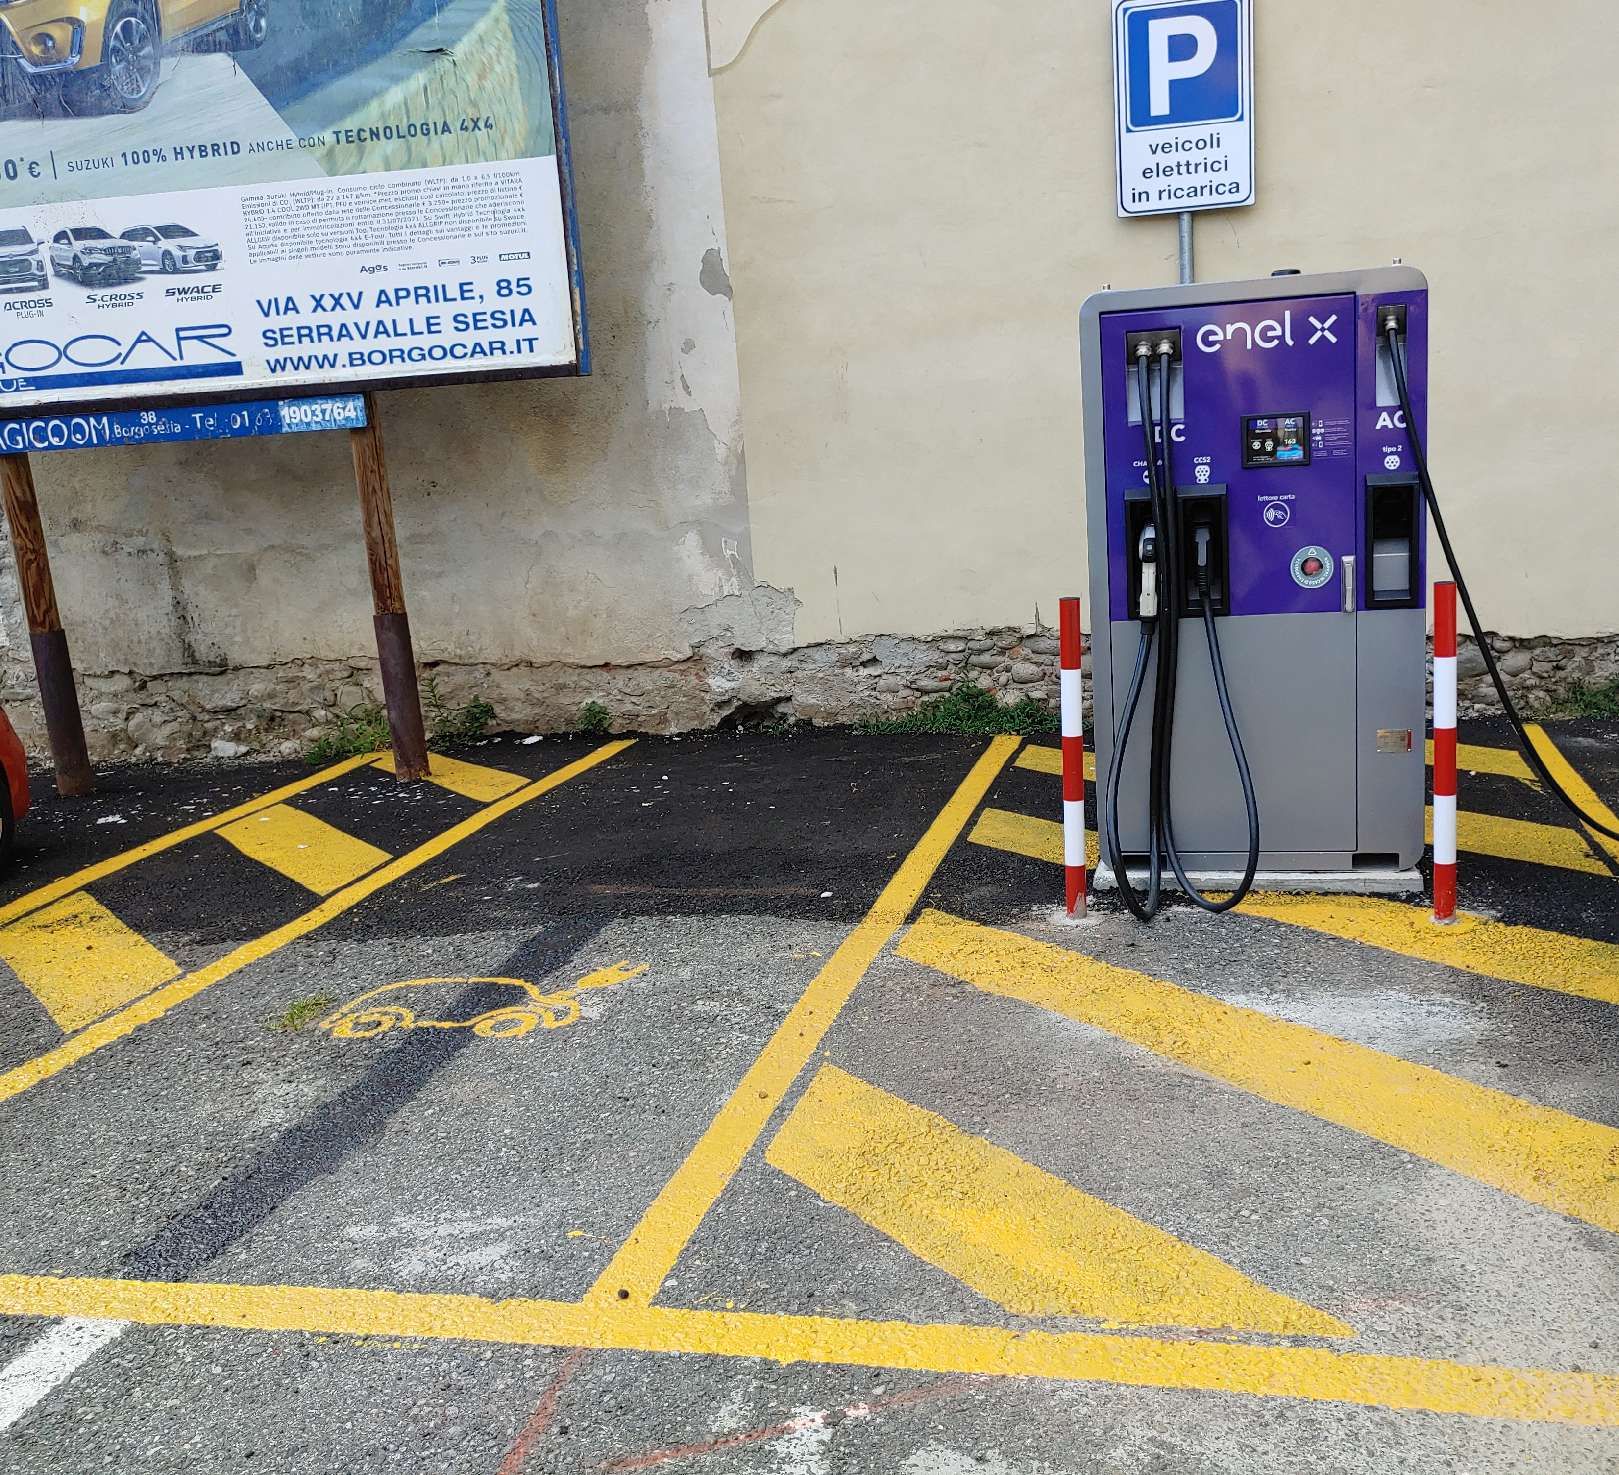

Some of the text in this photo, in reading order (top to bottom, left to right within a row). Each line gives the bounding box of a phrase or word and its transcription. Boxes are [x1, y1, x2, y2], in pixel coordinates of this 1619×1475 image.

[1148, 15, 1218, 117] P
[67, 116, 494, 172] SUZUKI 100% HYBRID ANCHE CON TECNOLOGIA 4X4
[1149, 132, 1220, 155] veicoli
[1142, 155, 1228, 179] elettrici
[1131, 180, 1240, 203] in ricarica
[360, 264, 388, 274] Agos
[165, 284, 223, 297] SWACE
[176, 294, 213, 303] HYBRID
[256, 277, 533, 318] VIA XXV APRILE, 85
[4, 298, 53, 312] ACROSS
[97, 301, 134, 309] HYBRID
[262, 307, 537, 348] SERRAVALLE SESIA
[1196, 309, 1295, 353] enel
[0, 323, 237, 375] OCAR
[266, 337, 539, 374] WWW.BORGOCAR.IT
[140, 411, 157, 424] 38
[282, 403, 357, 424] 1903764
[1284, 417, 1297, 425] AC
[1375, 410, 1407, 430] AC
[1193, 456, 1211, 464] CCS2
[1382, 445, 1397, 454] tipo
